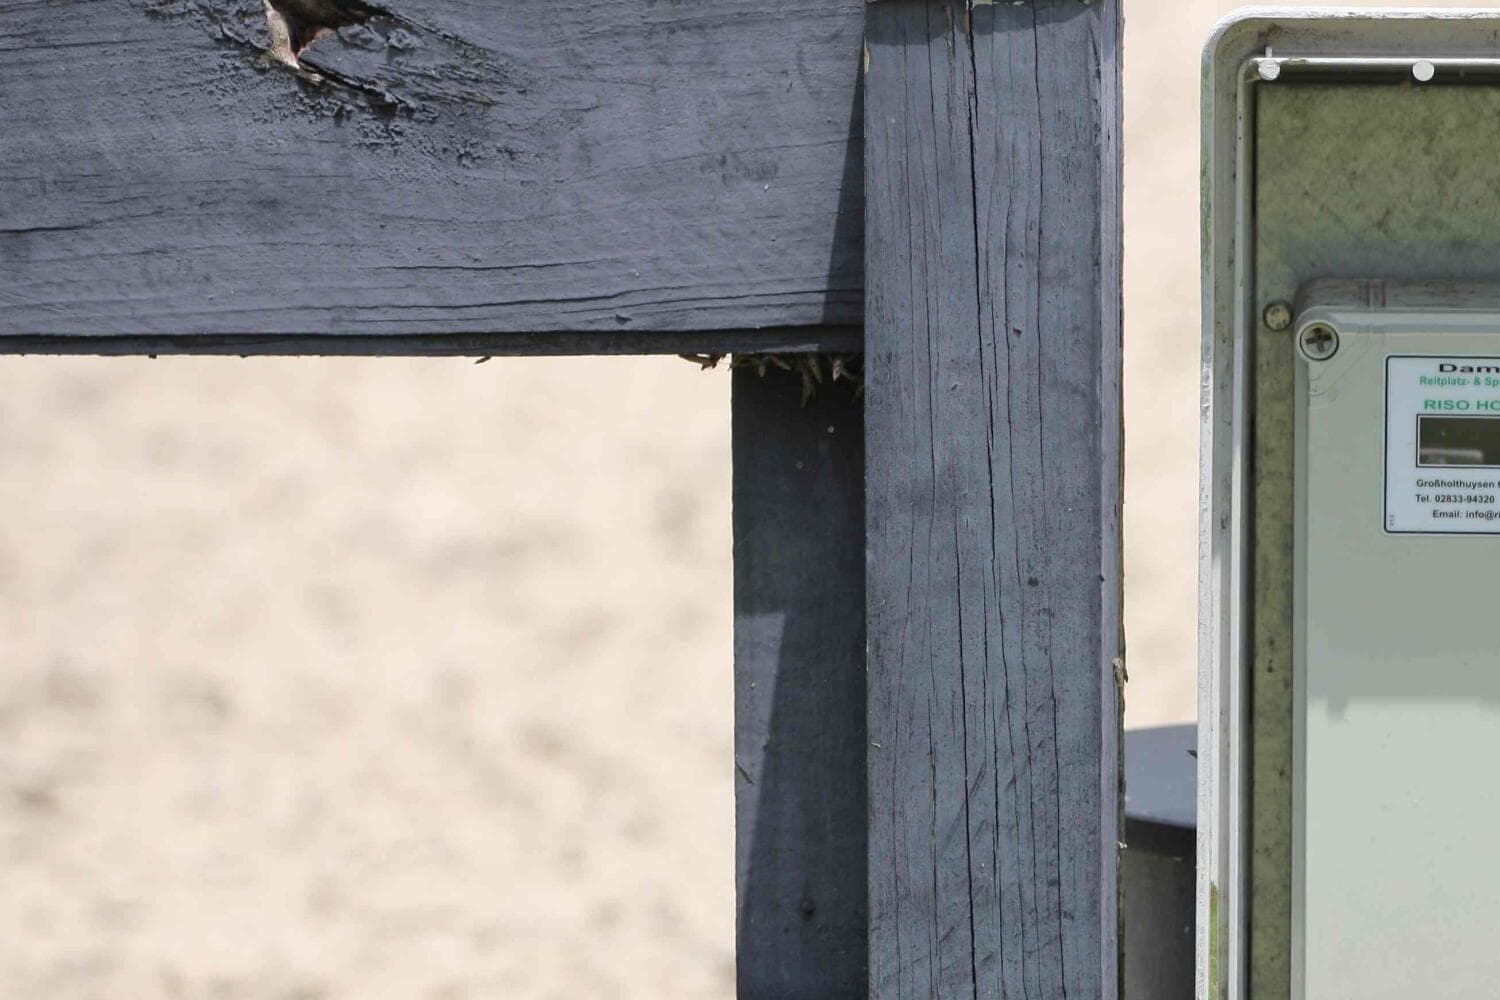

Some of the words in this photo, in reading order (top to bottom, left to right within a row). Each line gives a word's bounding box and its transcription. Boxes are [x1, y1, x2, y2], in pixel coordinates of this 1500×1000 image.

[1419, 376, 1470, 387] Reitplatz-
[1473, 376, 1481, 386] &
[1423, 399, 1470, 411] RISO
[1416, 479, 1495, 489] Großholthuysen
[1415, 494, 1431, 503] Tel.
[1435, 495, 1495, 504] 02833-94320
[1432, 510, 1463, 518] Email:
